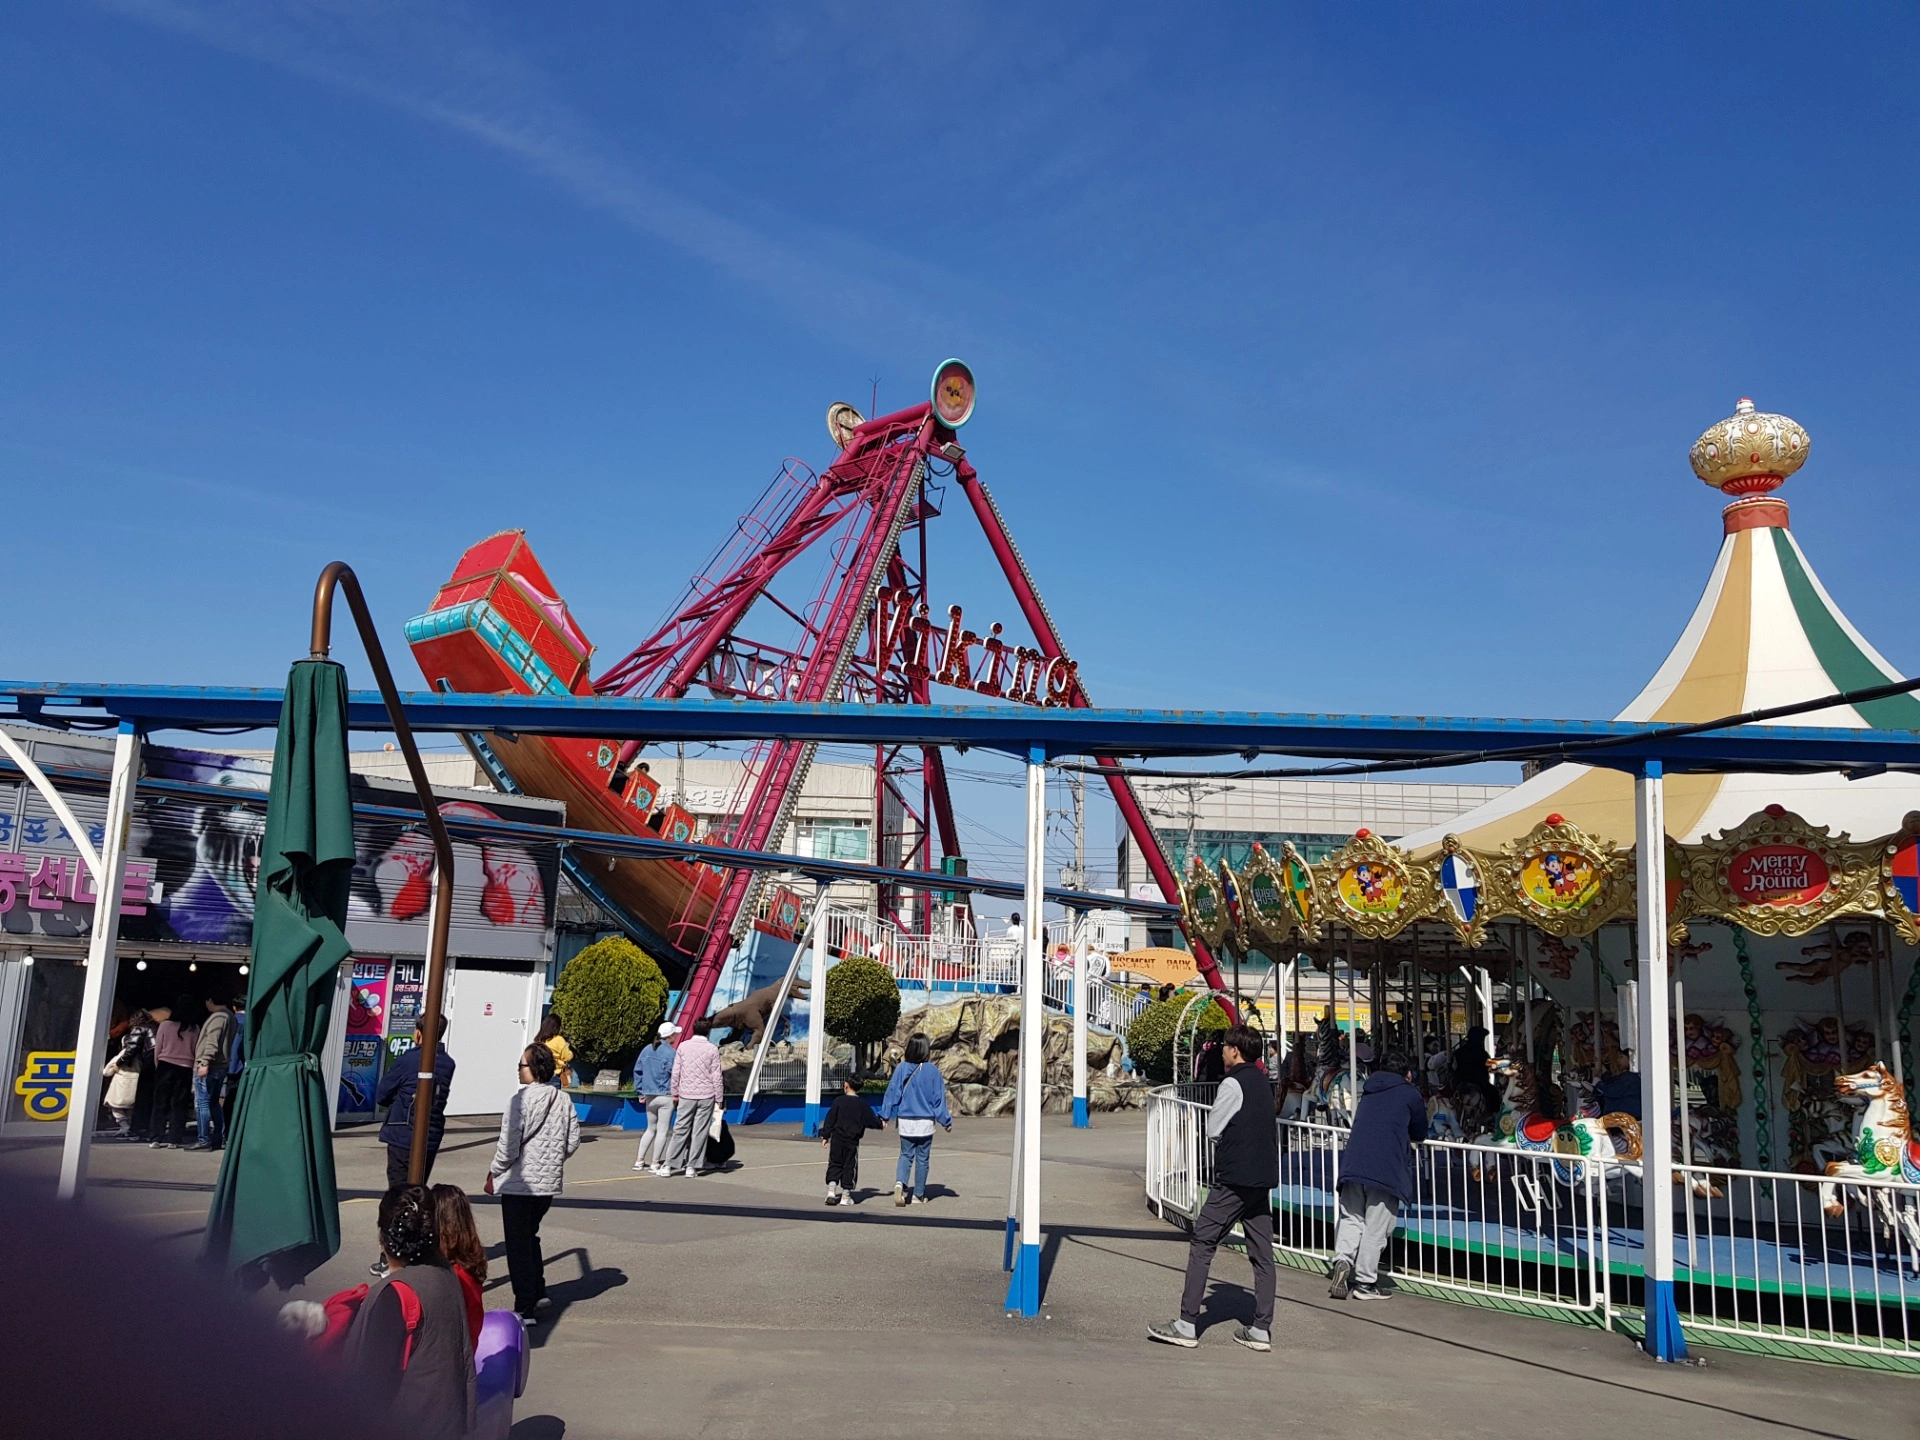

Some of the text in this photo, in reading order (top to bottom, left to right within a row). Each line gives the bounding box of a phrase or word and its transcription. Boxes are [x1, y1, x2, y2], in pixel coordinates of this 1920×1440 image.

[876, 585, 1078, 707] Viking
[1743, 855, 1808, 874] Merry
[1774, 867, 1792, 876] GO
[1743, 872, 1808, 892] Round
